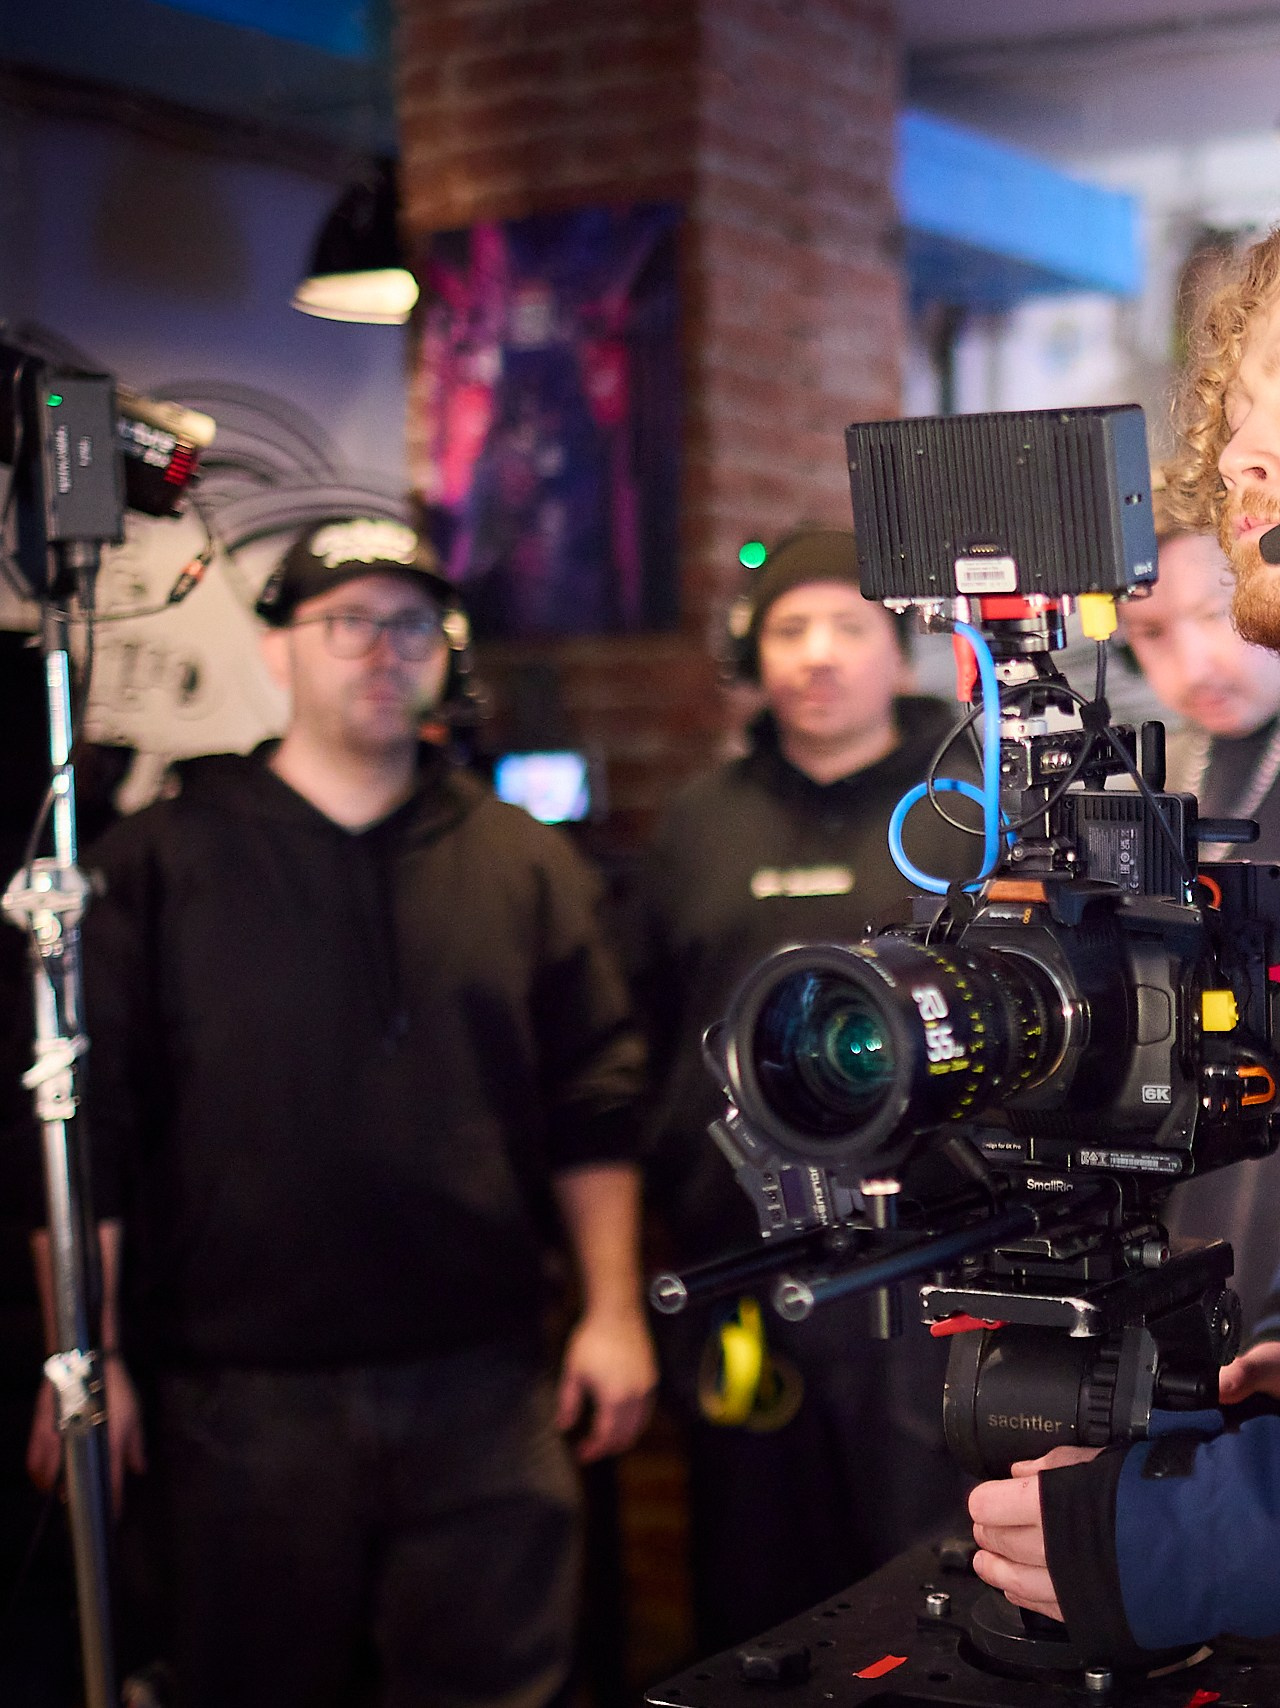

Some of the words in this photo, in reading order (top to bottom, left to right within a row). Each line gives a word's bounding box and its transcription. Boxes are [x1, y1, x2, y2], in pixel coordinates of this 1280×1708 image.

[911, 985, 949, 1021] 20
[1145, 1088, 1170, 1100] 6K
[808, 1166, 828, 1225] UCLEUS-M
[987, 1413, 1063, 1434] sachtler
